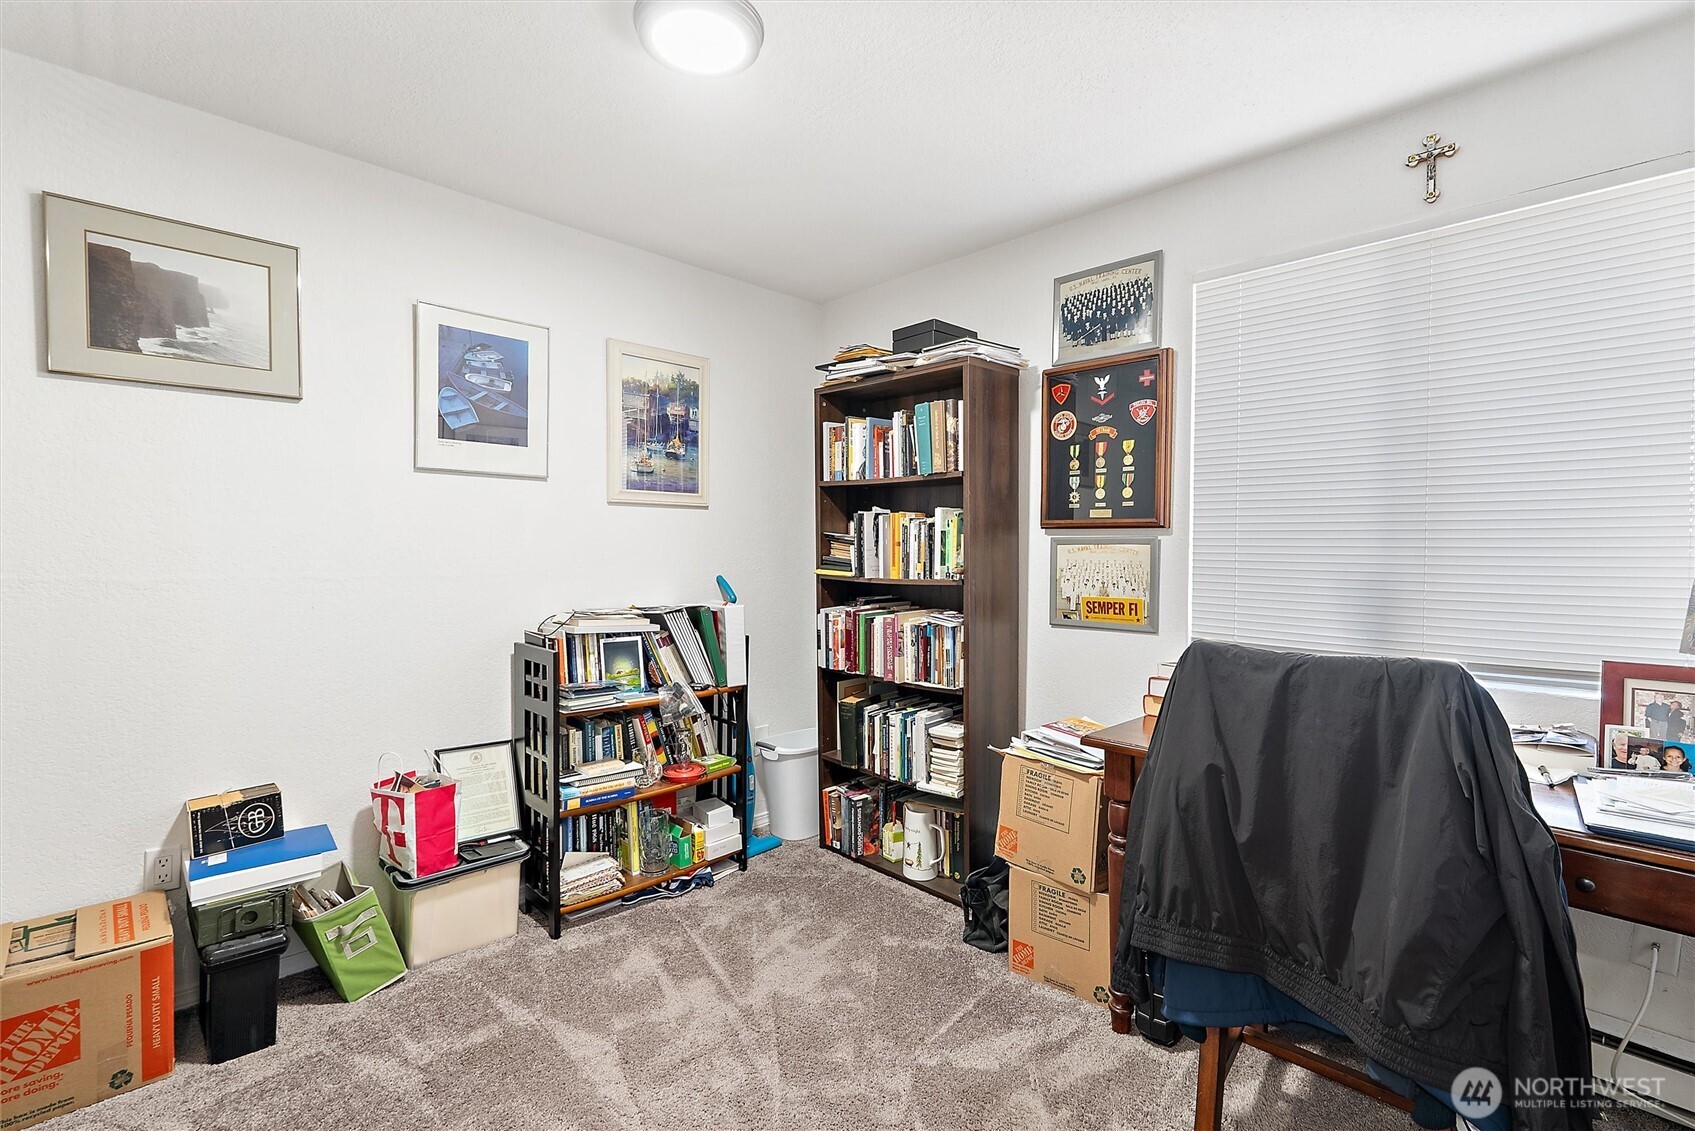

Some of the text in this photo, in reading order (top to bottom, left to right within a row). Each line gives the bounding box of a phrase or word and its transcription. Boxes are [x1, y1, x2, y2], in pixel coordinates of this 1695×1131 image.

[1096, 270, 1119, 280] TRAINING
[1086, 600, 1138, 616] SEMPER FI
[1026, 768, 1051, 781] FRAGILE
[1039, 884, 1065, 898] FRAGILE
[152, 976, 160, 1000] SMALL
[152, 1002, 160, 1022] DUTY
[0, 1020, 36, 1050] THE
[0, 1002, 80, 1084] HOME
[26, 1022, 80, 1072] DEPOT
[0, 1072, 63, 1095] ore saving.
[0, 1082, 59, 1104] ore doing.
